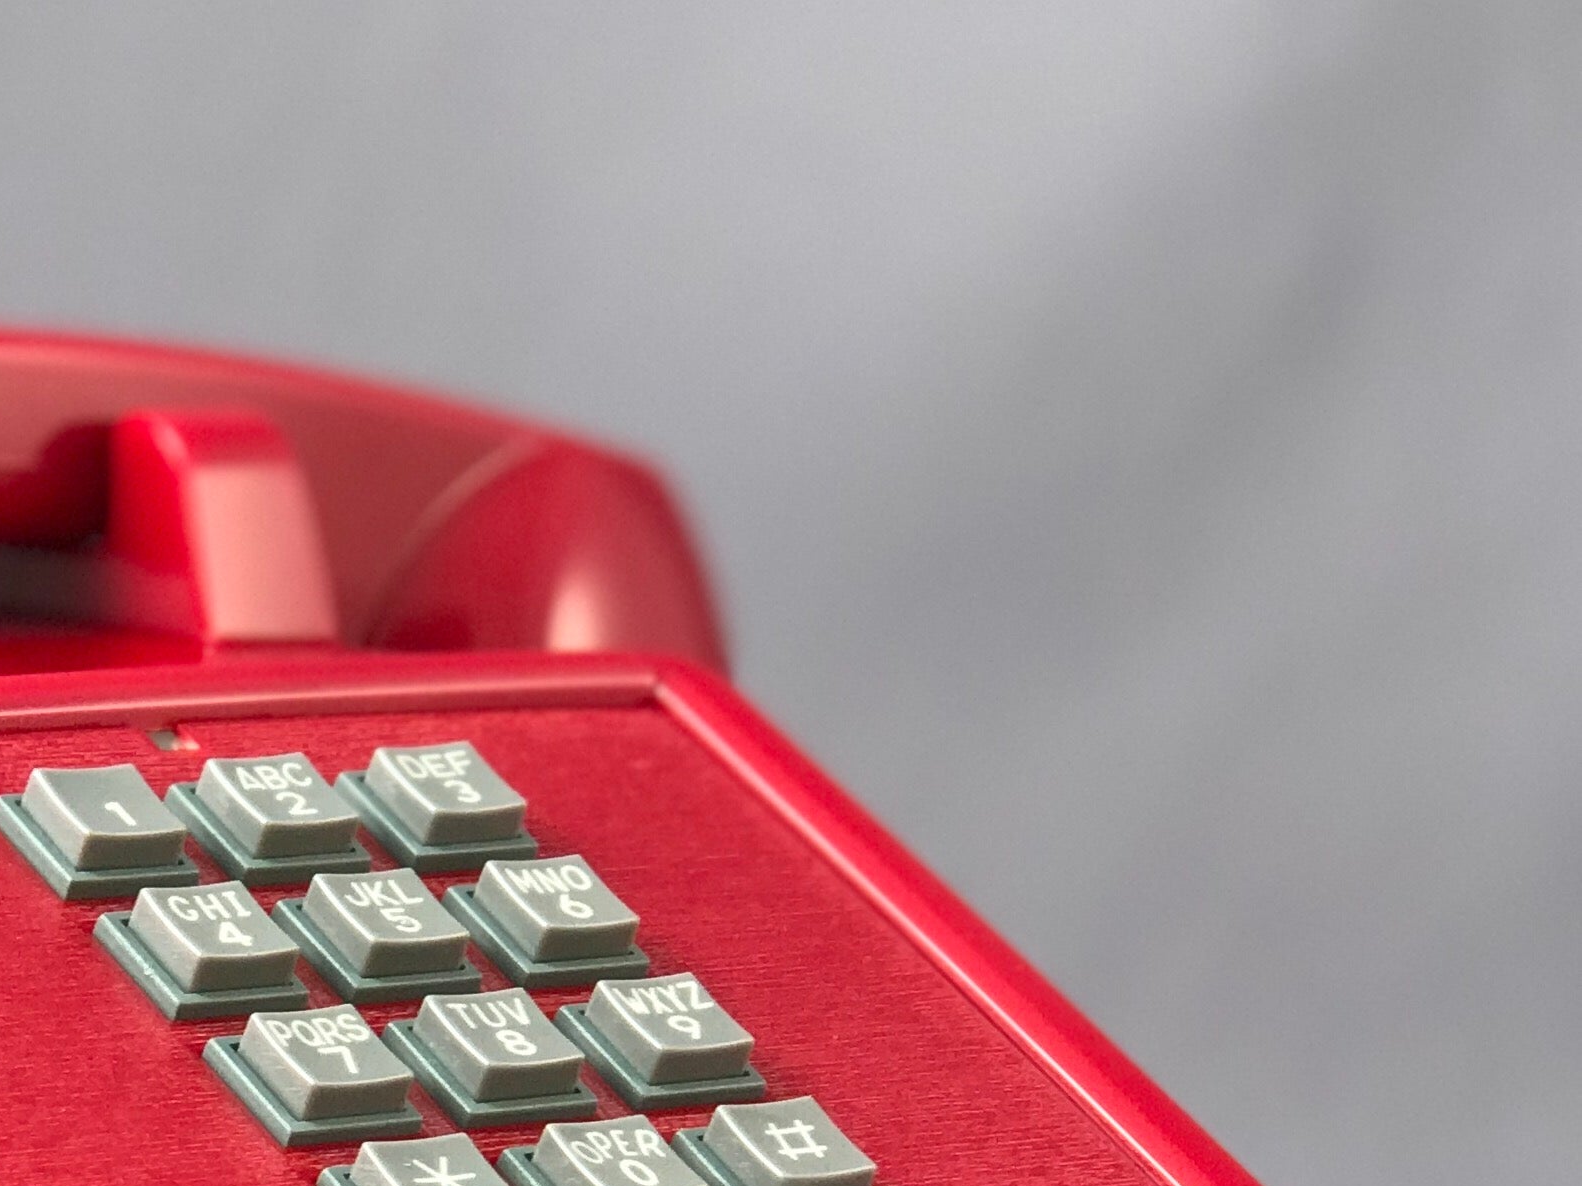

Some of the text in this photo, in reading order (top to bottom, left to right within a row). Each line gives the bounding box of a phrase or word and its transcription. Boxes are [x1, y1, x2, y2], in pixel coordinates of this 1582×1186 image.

[235, 761, 313, 792] ABC
[397, 750, 473, 780] DEF
[276, 787, 318, 816] 2
[443, 780, 481, 803] 3
[104, 801, 137, 826] 1
[343, 879, 425, 907] JKL
[504, 865, 593, 894] MNO
[167, 888, 252, 922] GHI
[380, 907, 422, 932] 5
[559, 893, 594, 919] 6
[218, 921, 254, 947] 4
[614, 982, 714, 1015] WXYZ
[446, 998, 531, 1030] TUV
[666, 1013, 703, 1040] 9
[267, 1013, 371, 1048] PQRS
[495, 1028, 538, 1057] 8
[318, 1046, 360, 1074] 7
[572, 1129, 665, 1164] OPER
